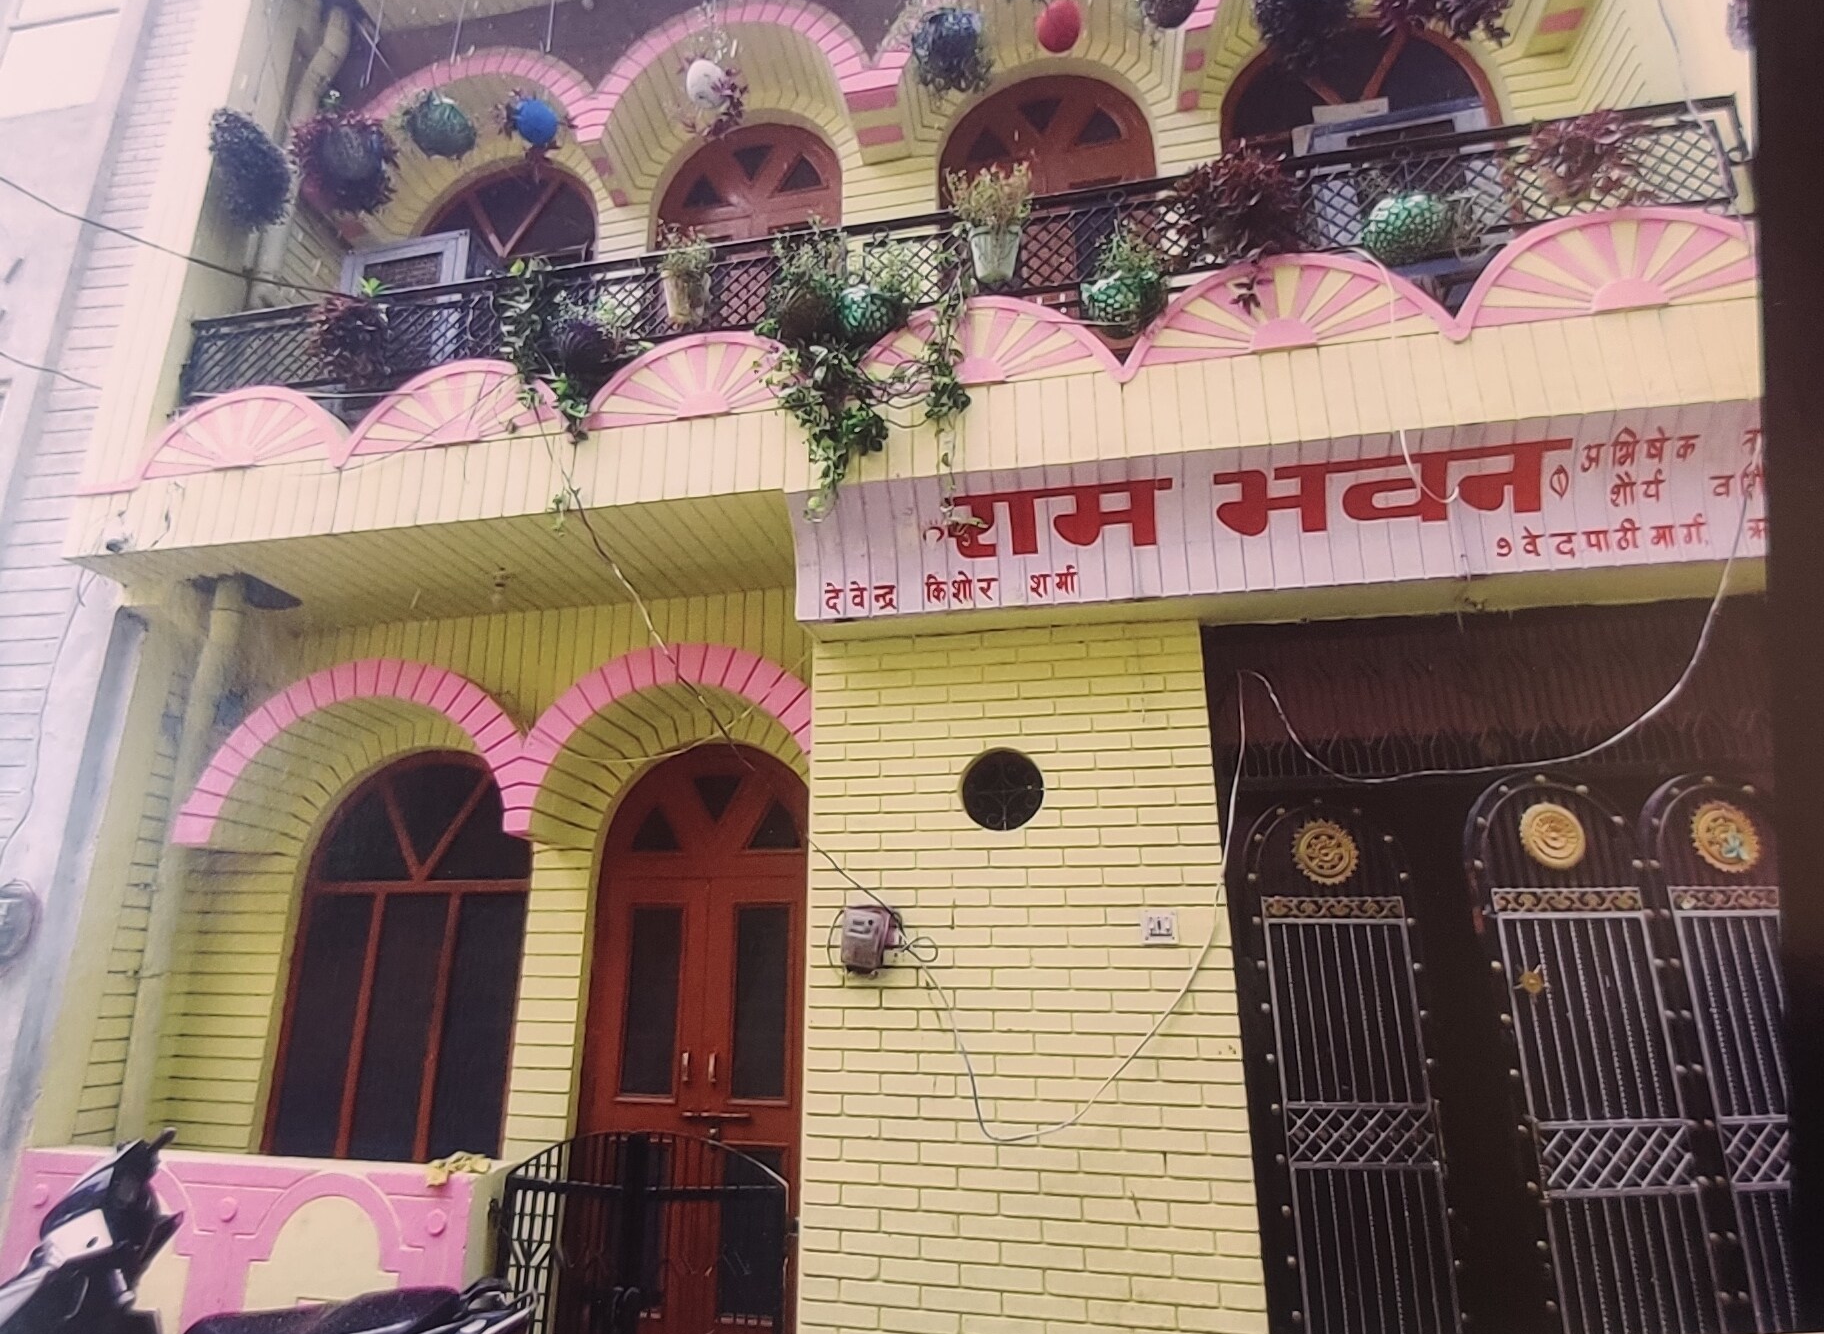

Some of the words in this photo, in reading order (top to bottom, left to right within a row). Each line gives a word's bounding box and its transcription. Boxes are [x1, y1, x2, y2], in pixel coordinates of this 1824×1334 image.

[946, 477, 1172, 558] राम
[1212, 438, 1573, 536] भवन
[824, 581, 897, 614] देवेन्द्र
[925, 570, 999, 603] किशोर
[1029, 564, 1078, 598] शर्मा
